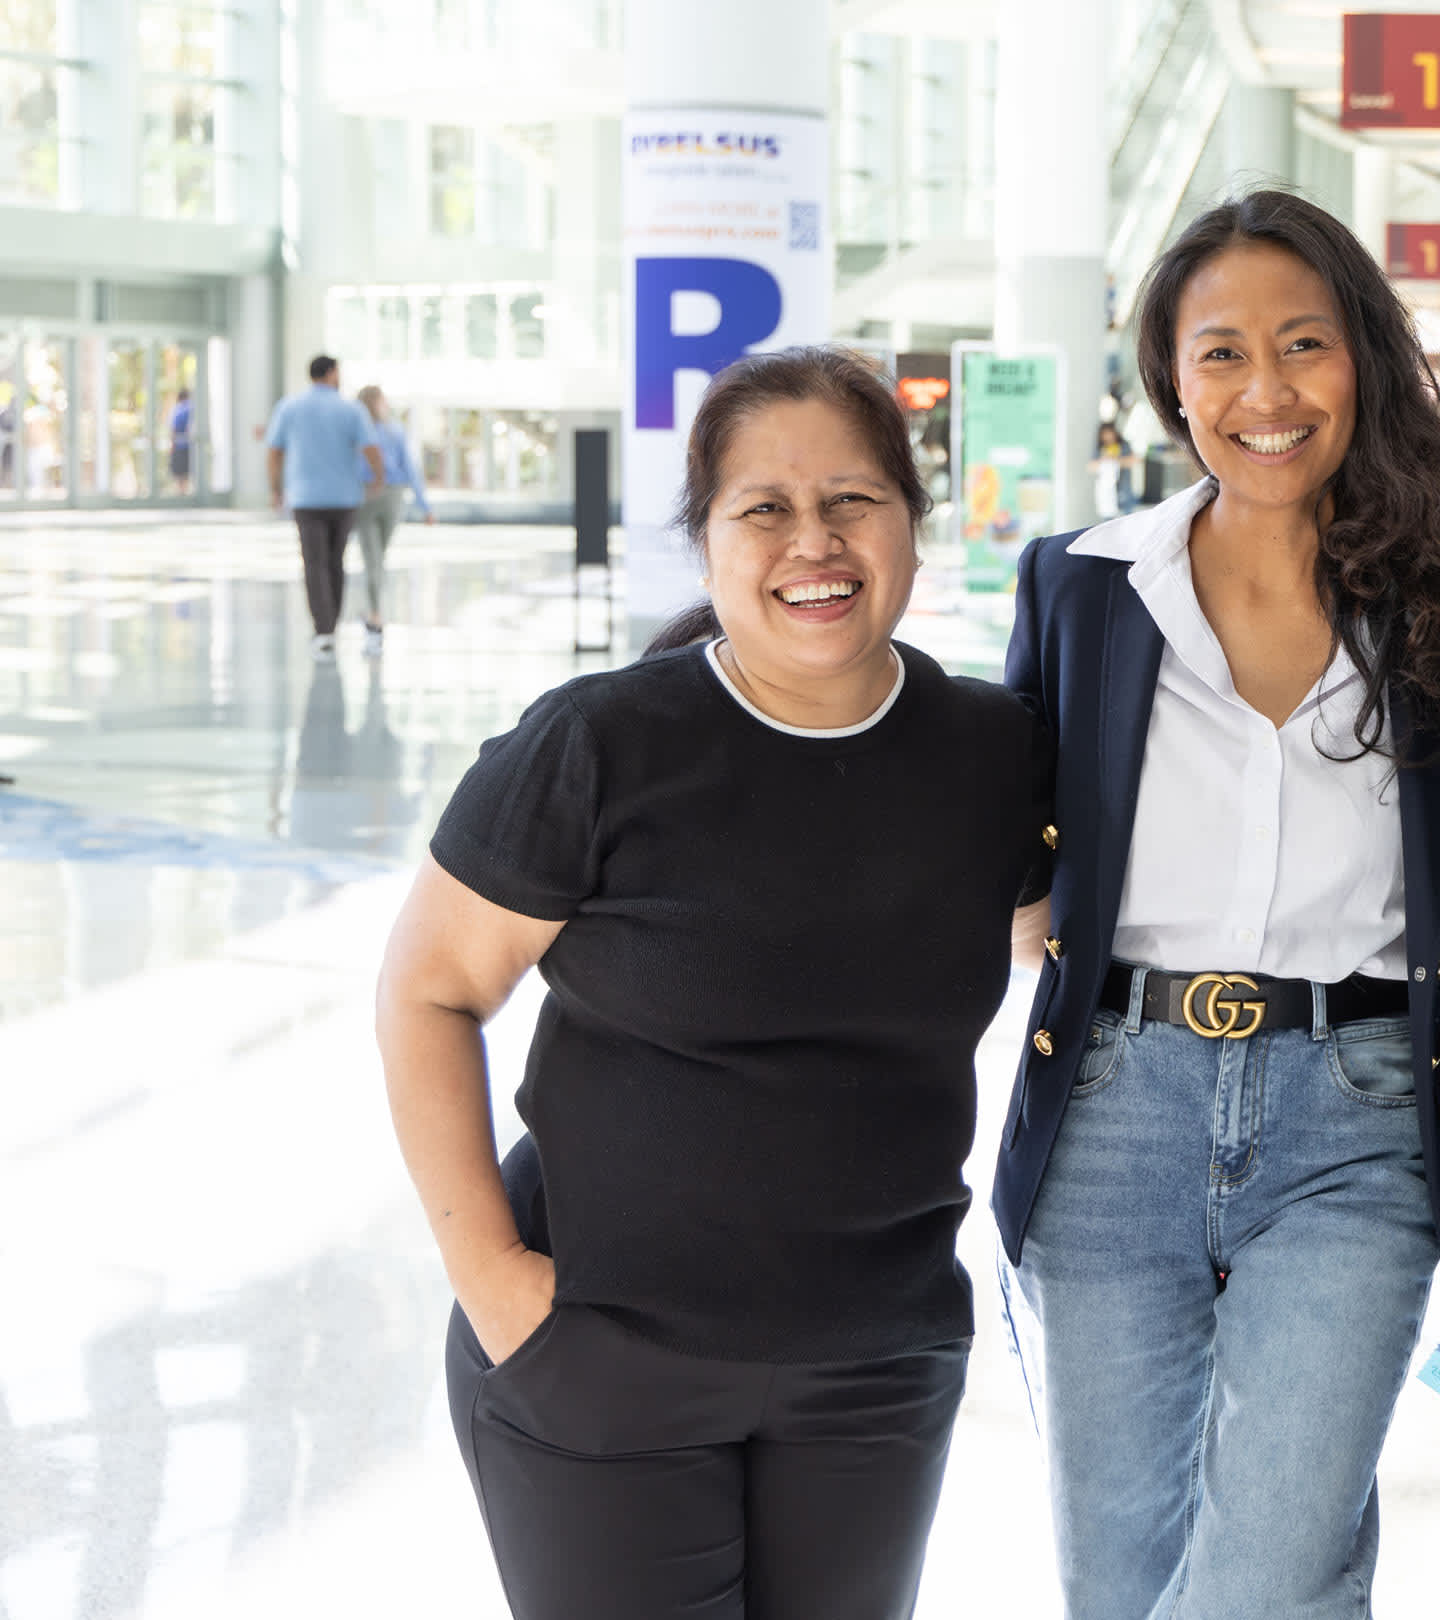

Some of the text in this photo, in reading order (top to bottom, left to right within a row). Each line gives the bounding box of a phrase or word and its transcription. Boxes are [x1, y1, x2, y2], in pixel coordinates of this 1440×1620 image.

[1412, 51, 1440, 110] 1
[1420, 240, 1438, 273] 1
[635, 256, 782, 430] R
